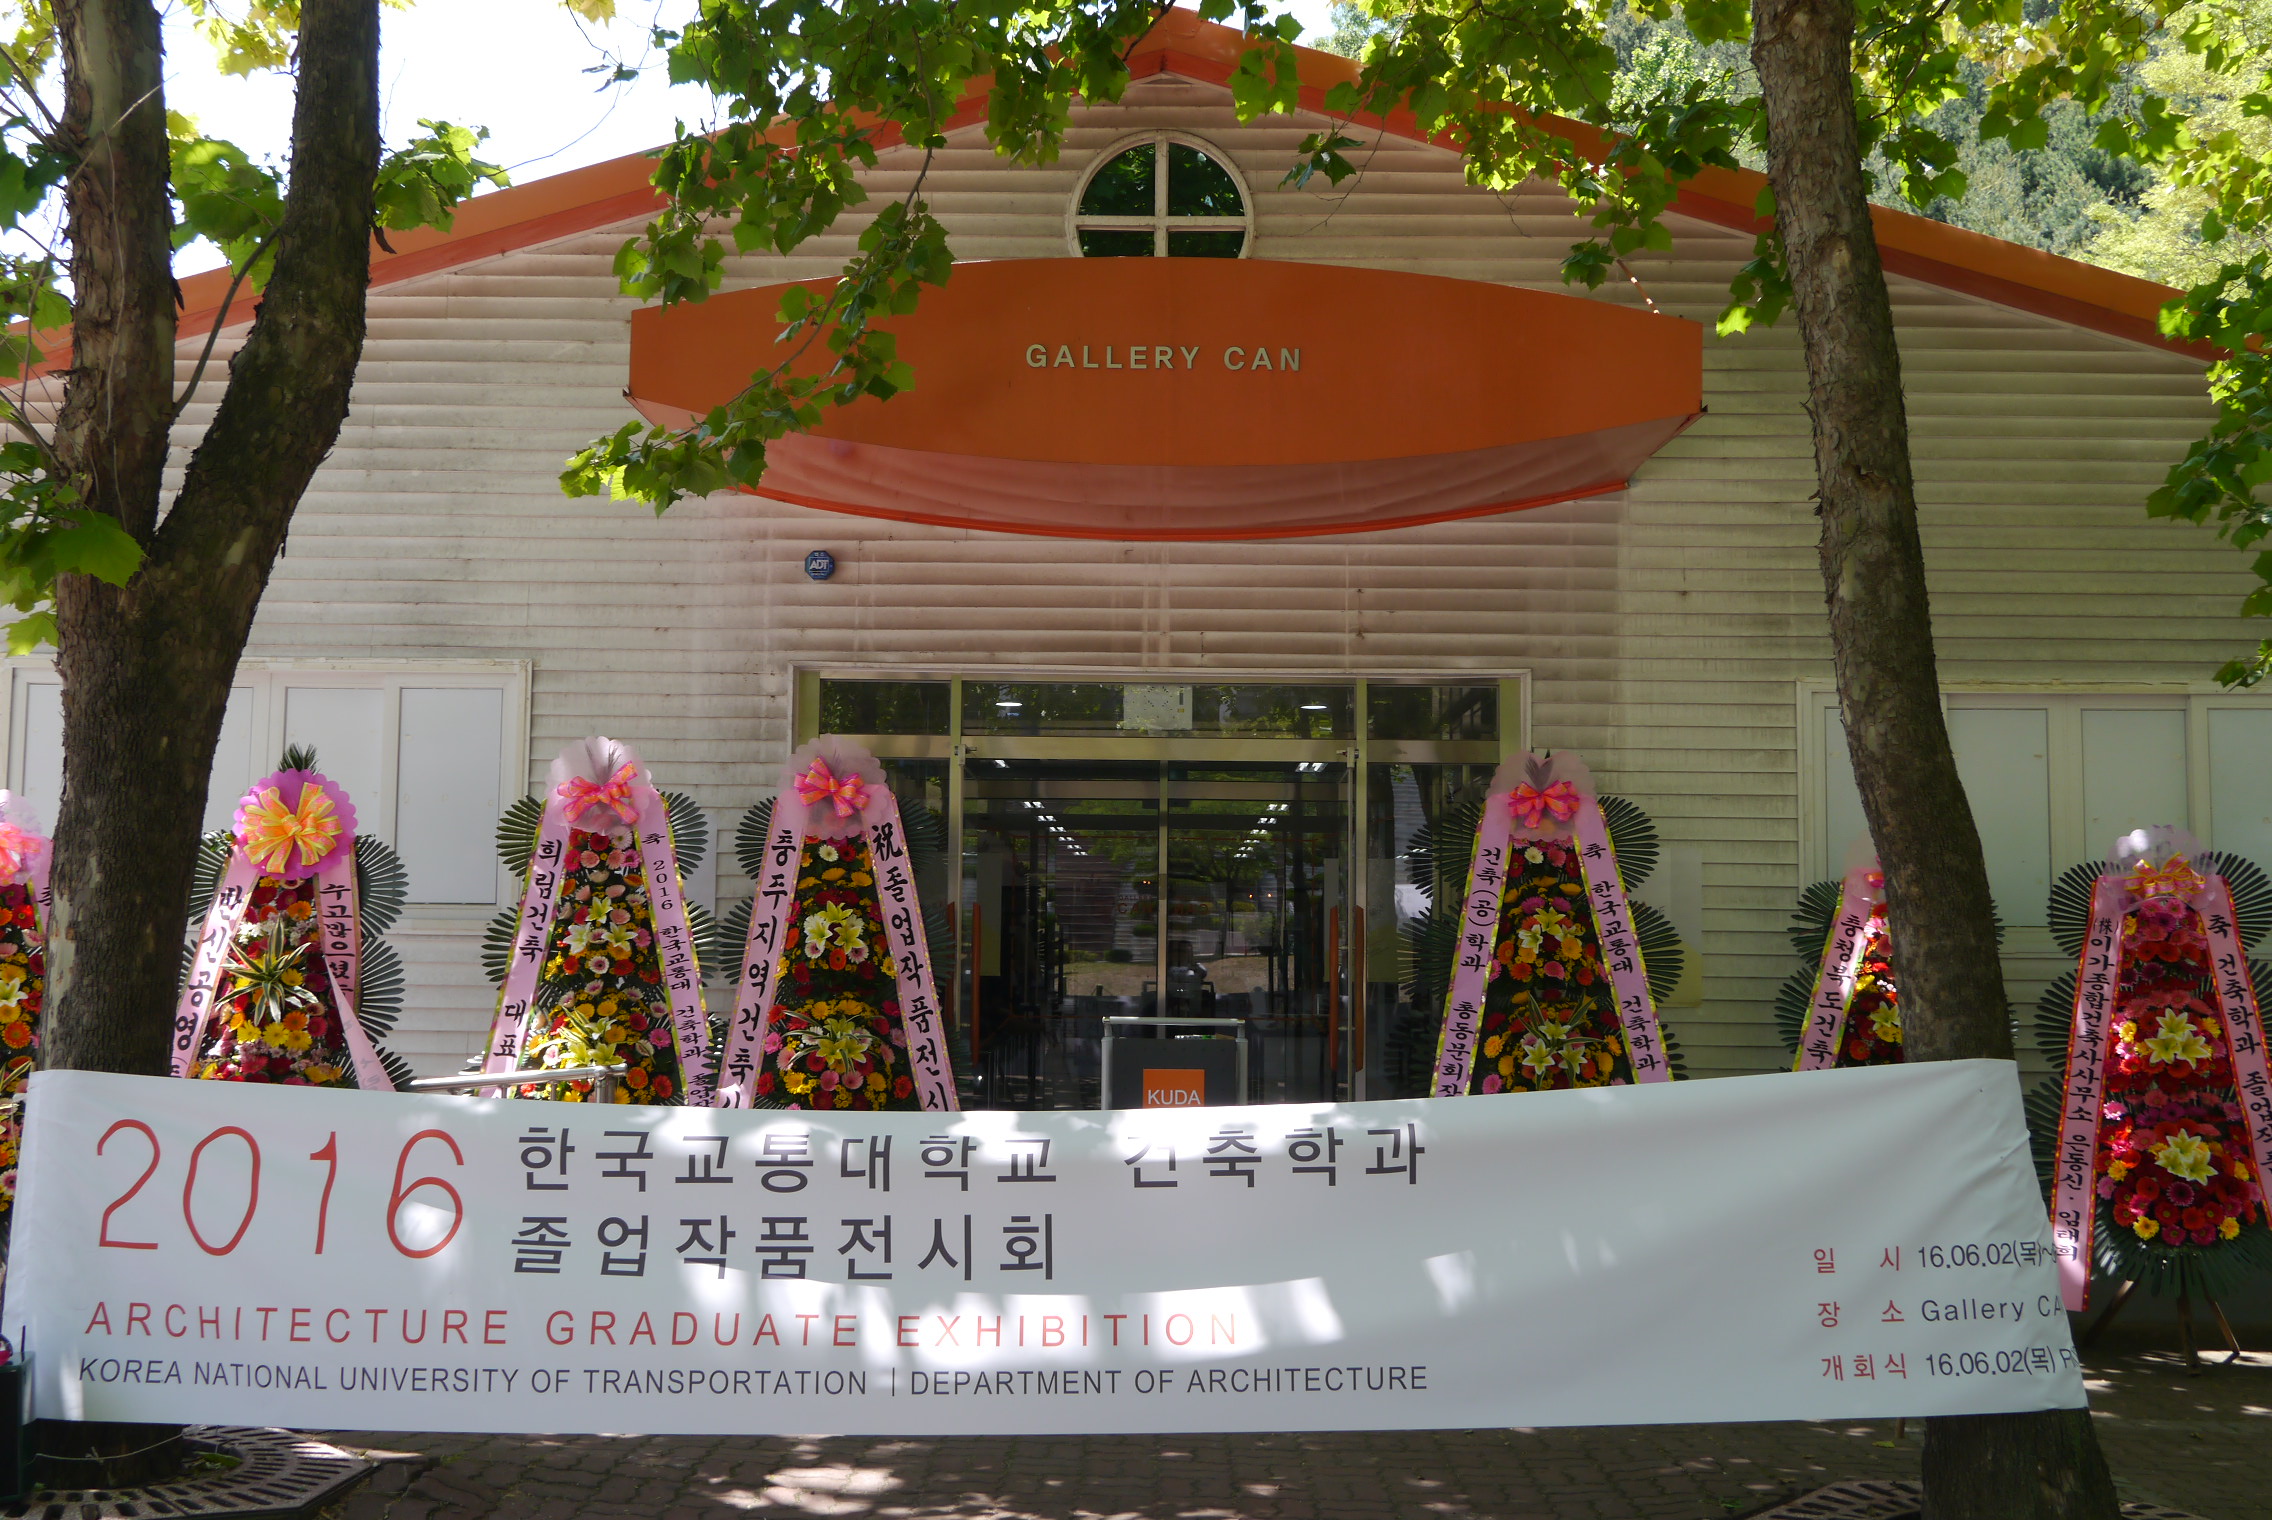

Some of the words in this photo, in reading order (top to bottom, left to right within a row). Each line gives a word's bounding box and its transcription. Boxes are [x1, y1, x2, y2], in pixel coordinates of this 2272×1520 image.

[1025, 344, 1200, 369] GALLERY
[1223, 346, 1300, 371] CAN
[810, 559, 830, 570] ADT
[1582, 843, 1606, 860] 축
[519, 838, 562, 964] 희림건축
[652, 860, 673, 911] 2016
[1591, 880, 1634, 974] 한국교통대
[2206, 914, 2232, 939] 축
[659, 925, 692, 991] 한국교통대
[1807, 914, 1864, 1070] 충청북도건축
[2217, 953, 2261, 1056] 건축학과
[493, 999, 526, 1059] 대표
[676, 1004, 705, 1059] 건축학과
[1621, 994, 1661, 1072] 건축학과
[1147, 1089, 1202, 1106] KUDA
[518, 1126, 1057, 1193] 한국교통대학교
[96, 1118, 465, 1260] 2016
[511, 1213, 1053, 1281] 졸업작품전시회
[1813, 1247, 1836, 1274] 일
[1879, 1245, 1901, 1271] 시
[84, 1301, 508, 1345] ARCHITECTURE
[545, 1309, 857, 1347] GRADUATE
[896, 1313, 1237, 1348] EXHIBITION
[1817, 1301, 1841, 1328] 장
[1880, 1299, 1905, 1323] 소
[1921, 1297, 2025, 1322] Gallery
[78, 1357, 183, 1385] KOREA
[193, 1361, 328, 1391] NATIONAL
[340, 1365, 519, 1394] UNIVERSITY
[531, 1369, 571, 1394] OF
[583, 1368, 867, 1395] TRANSPORTATION
[911, 1369, 1122, 1396] DEPARTMENT
[1134, 1369, 1174, 1395] OF
[1186, 1365, 1428, 1394] ARCHITECTURE
[1821, 1352, 1908, 1381] 개회식
[1926, 1344, 2057, 1377] 16.06.02(목)
